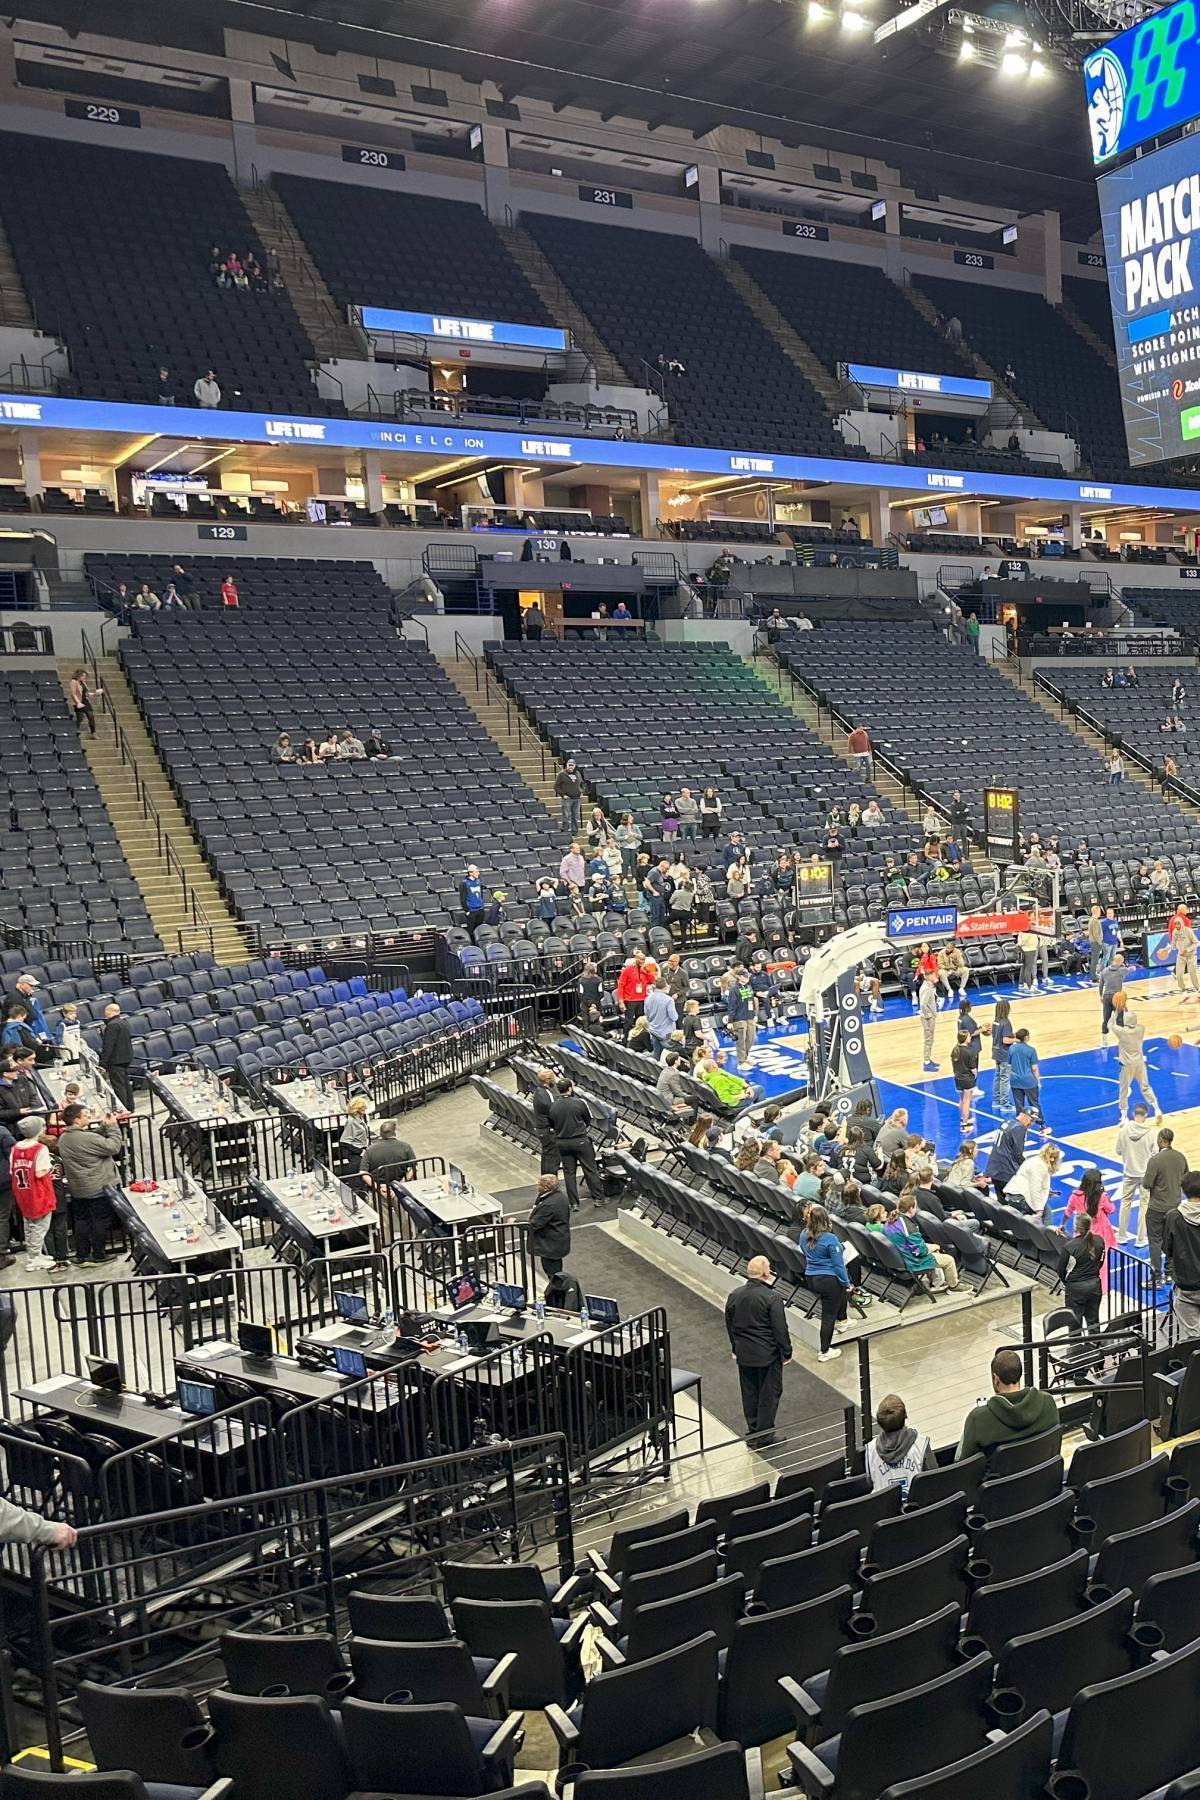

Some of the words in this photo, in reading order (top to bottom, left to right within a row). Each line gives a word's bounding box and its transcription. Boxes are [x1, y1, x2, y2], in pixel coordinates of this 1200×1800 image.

[86, 105, 120, 124] 229
[360, 150, 389, 167] 230
[593, 190, 617, 206] 231
[795, 225, 816, 238] 232
[965, 253, 983, 267] 233
[1087, 255, 1103, 266] 234
[1124, 239, 1194, 312] PACK
[1132, 336, 1166, 358] SCORE
[1133, 357, 1155, 375] WIN
[210, 527, 235, 540] 129
[536, 539, 557, 551] 130
[1007, 562, 1022, 571] 132
[1185, 569, 1198, 578] 133
[906, 914, 953, 928] PENTAIR
